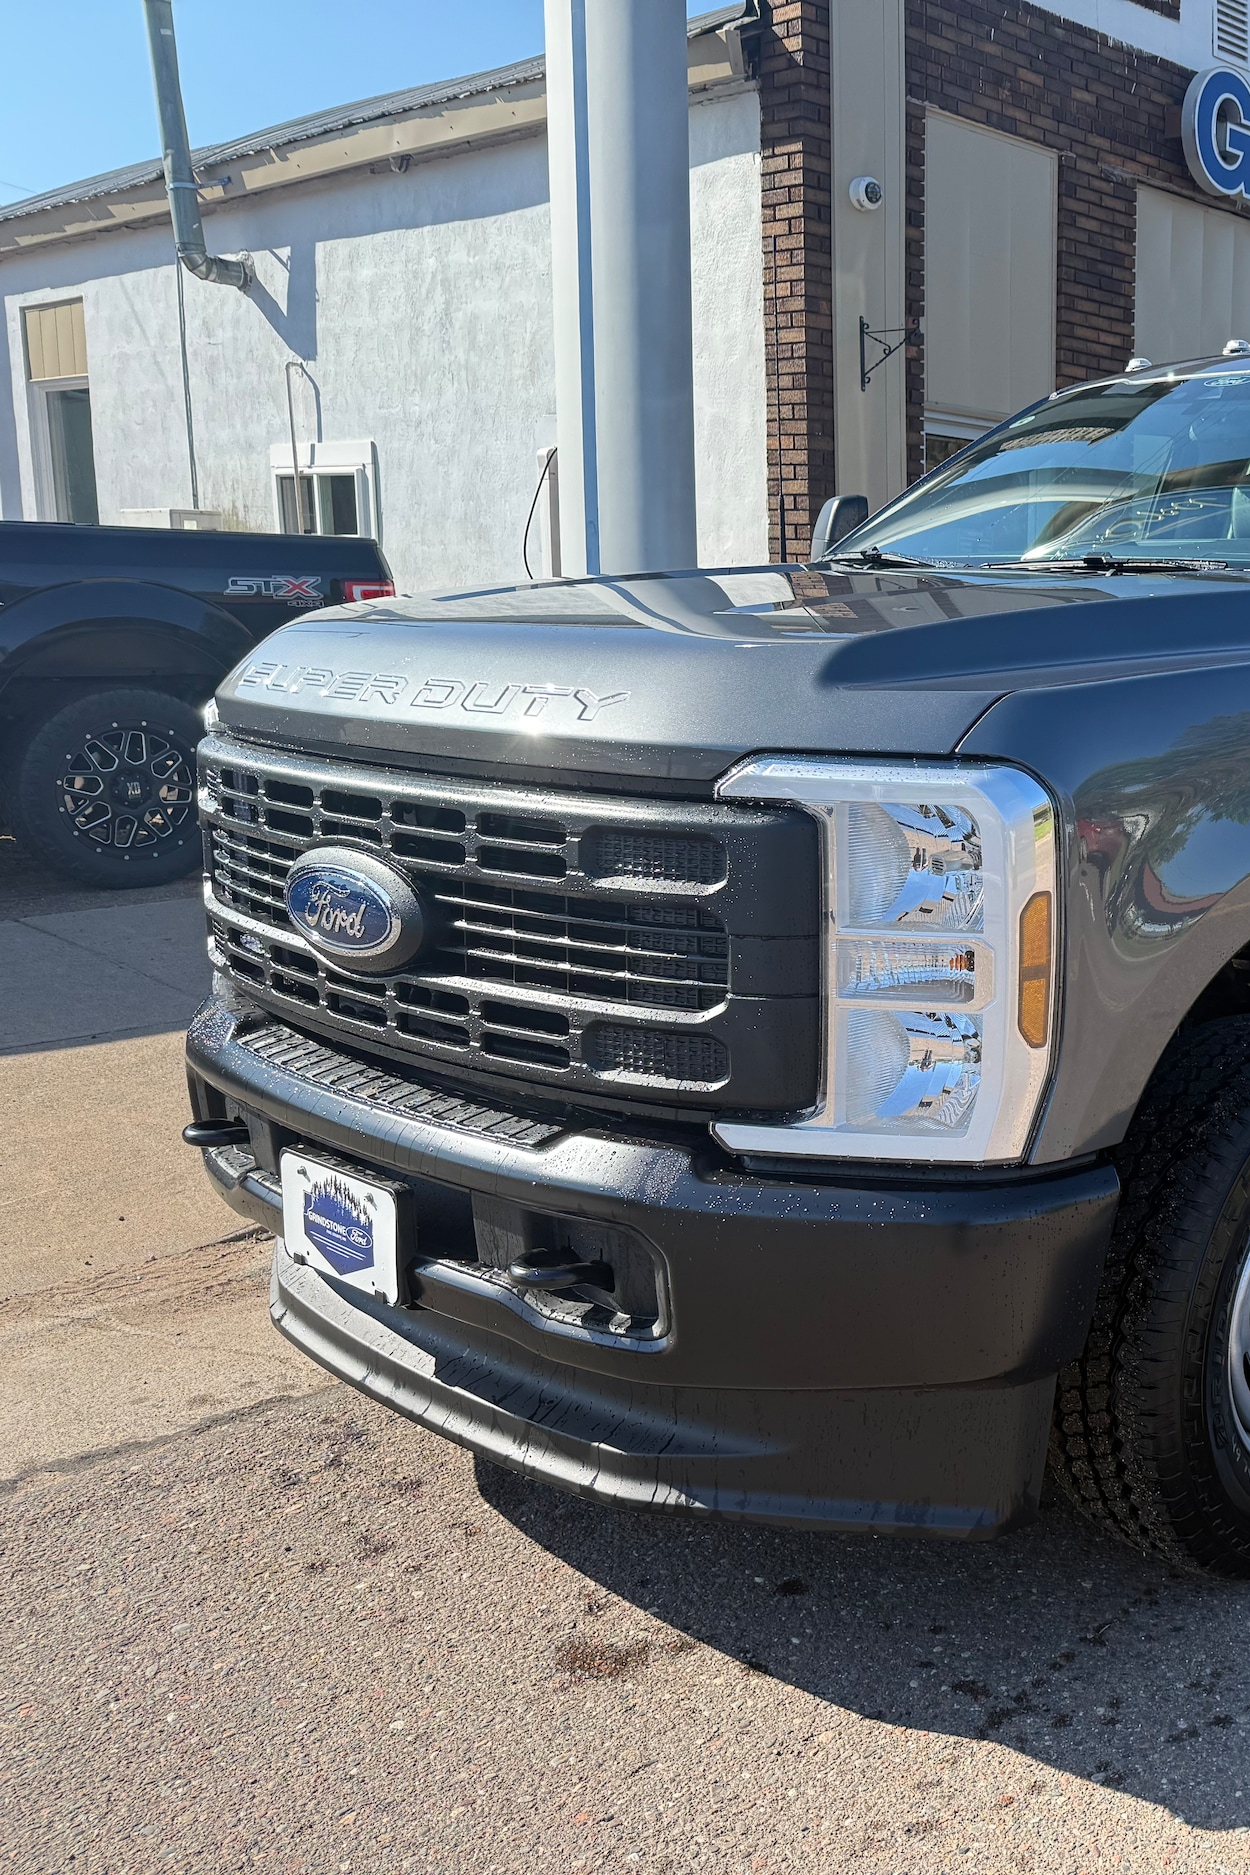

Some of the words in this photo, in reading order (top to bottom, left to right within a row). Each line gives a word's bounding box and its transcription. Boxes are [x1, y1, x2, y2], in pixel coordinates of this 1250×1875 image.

[223, 575, 324, 599] STX
[239, 662, 409, 704] SUPER
[410, 677, 632, 721] DUTY
[305, 880, 364, 938] Ford
[308, 1210, 347, 1236] GRINDSTONE
[350, 1229, 368, 1246] Ford
